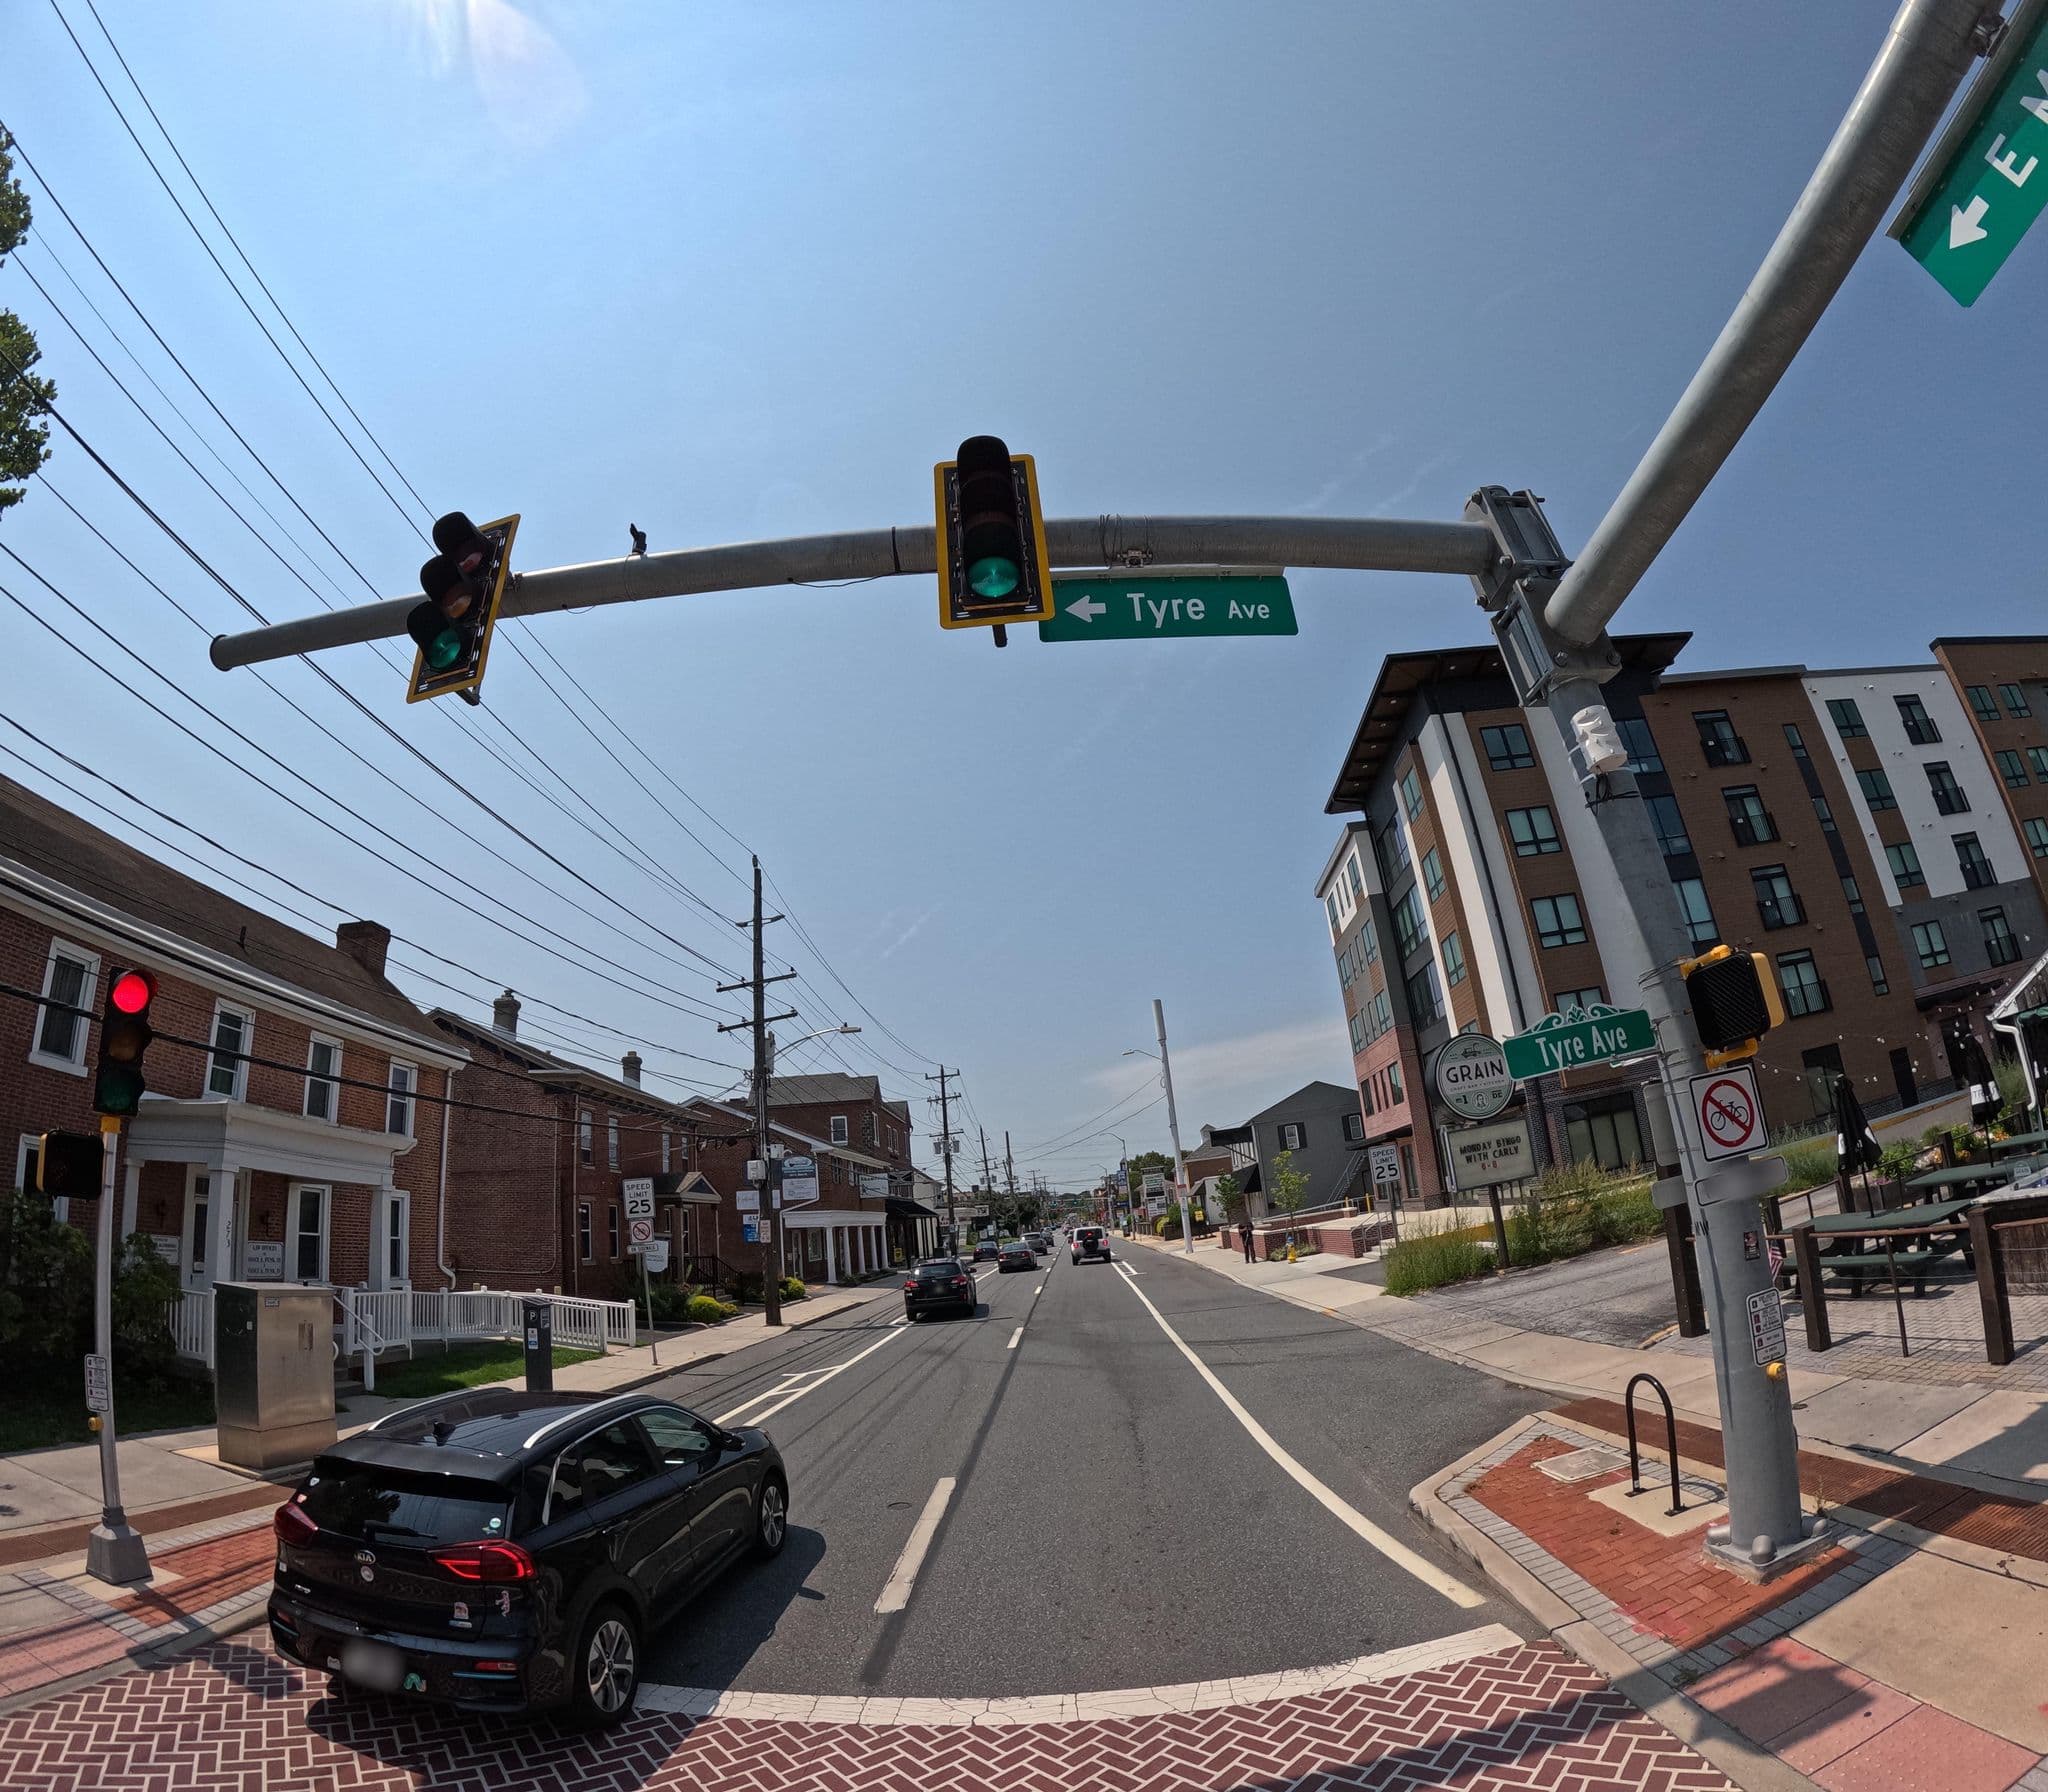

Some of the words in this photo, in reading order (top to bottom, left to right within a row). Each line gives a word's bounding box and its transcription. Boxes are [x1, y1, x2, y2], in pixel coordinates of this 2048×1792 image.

[1984, 132, 2039, 188] E
[1127, 592, 1206, 629] Tyre
[1228, 600, 1271, 620] Ave
[1535, 1036, 1585, 1069] Tyre
[1591, 1025, 1628, 1056] Ave
[1445, 1058, 1505, 1084] GRAIN
[1373, 1150, 1395, 1158] SPEED
[1459, 1140, 1492, 1155] MONDAY
[1496, 1136, 1521, 1148] BINGO
[1465, 1152, 1489, 1164] WITH
[1493, 1145, 1519, 1159] CARLY
[1376, 1157, 1393, 1165] LIMIT
[1375, 1163, 1398, 1180] 25
[626, 1183, 651, 1191] SPEED
[629, 1191, 647, 1199] LIMIT
[628, 1200, 651, 1214] 25
